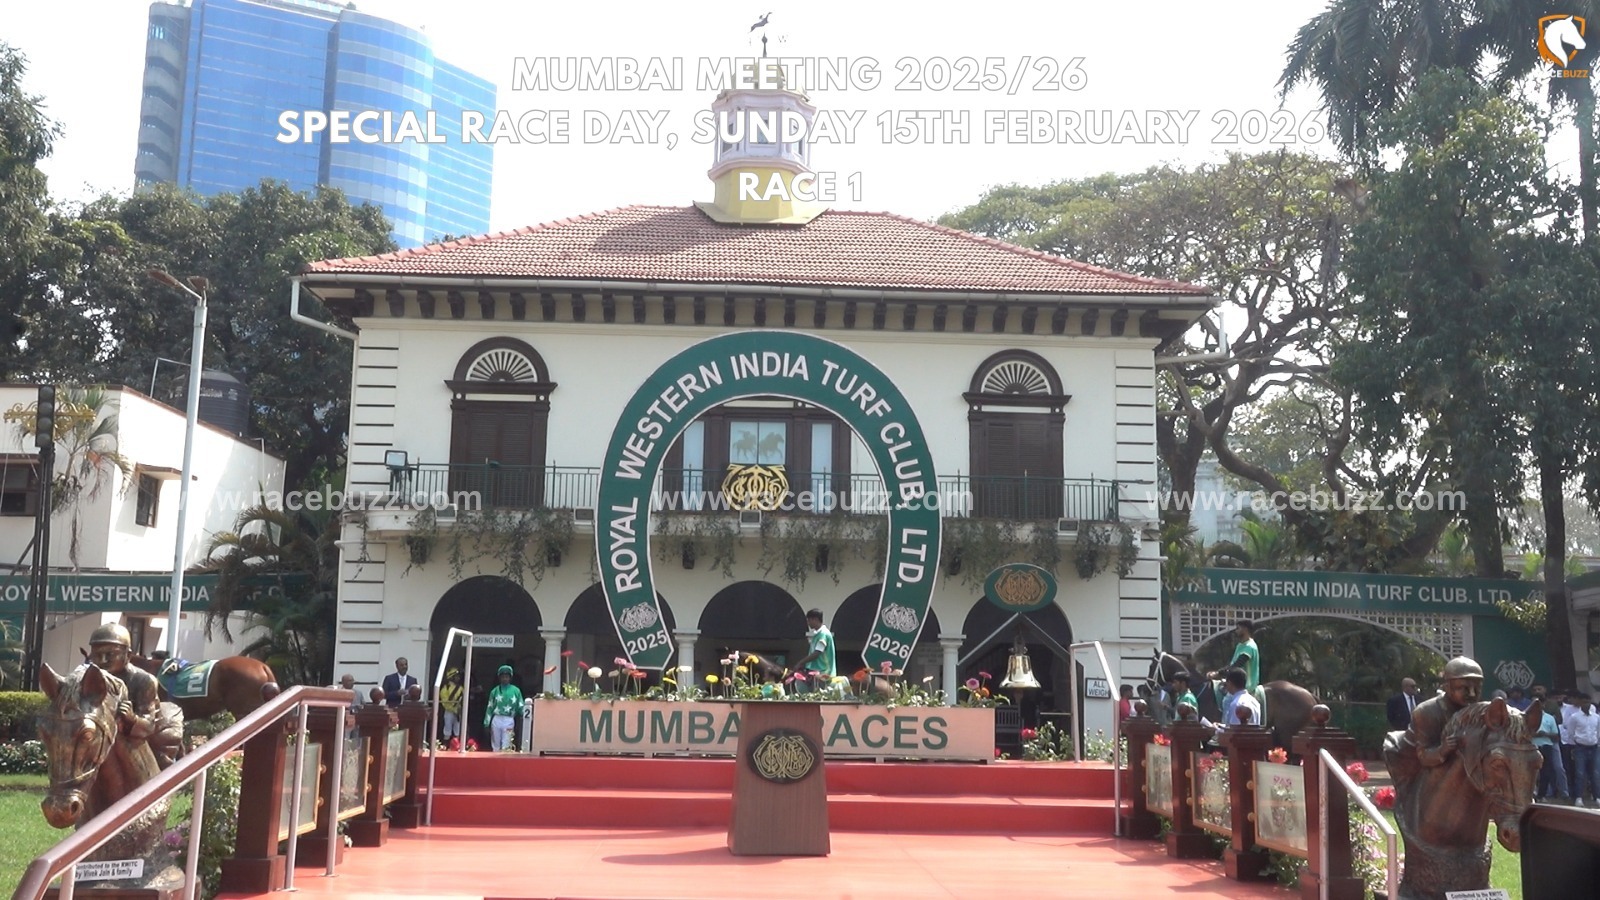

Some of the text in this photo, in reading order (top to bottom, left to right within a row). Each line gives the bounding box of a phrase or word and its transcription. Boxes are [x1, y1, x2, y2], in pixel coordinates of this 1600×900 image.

[730, 351, 810, 381] INDIA
[820, 359, 892, 417] TURF
[615, 361, 724, 480] WESTERN
[610, 497, 643, 593] ROYAL
[896, 528, 928, 588] LTD.
[61, 585, 153, 602] WESTERN
[1221, 579, 1308, 597] WESTERN
[1313, 582, 1361, 599] INDIA
[1366, 584, 1412, 601] TURF
[1418, 587, 1473, 604] CLUB.
[494, 637, 513, 645] ROOM
[627, 631, 669, 656] 2025
[869, 633, 910, 659] 2026
[187, 672, 205, 693] 2
[524, 708, 531, 719] 2
[580, 709, 743, 745] MUMBA
